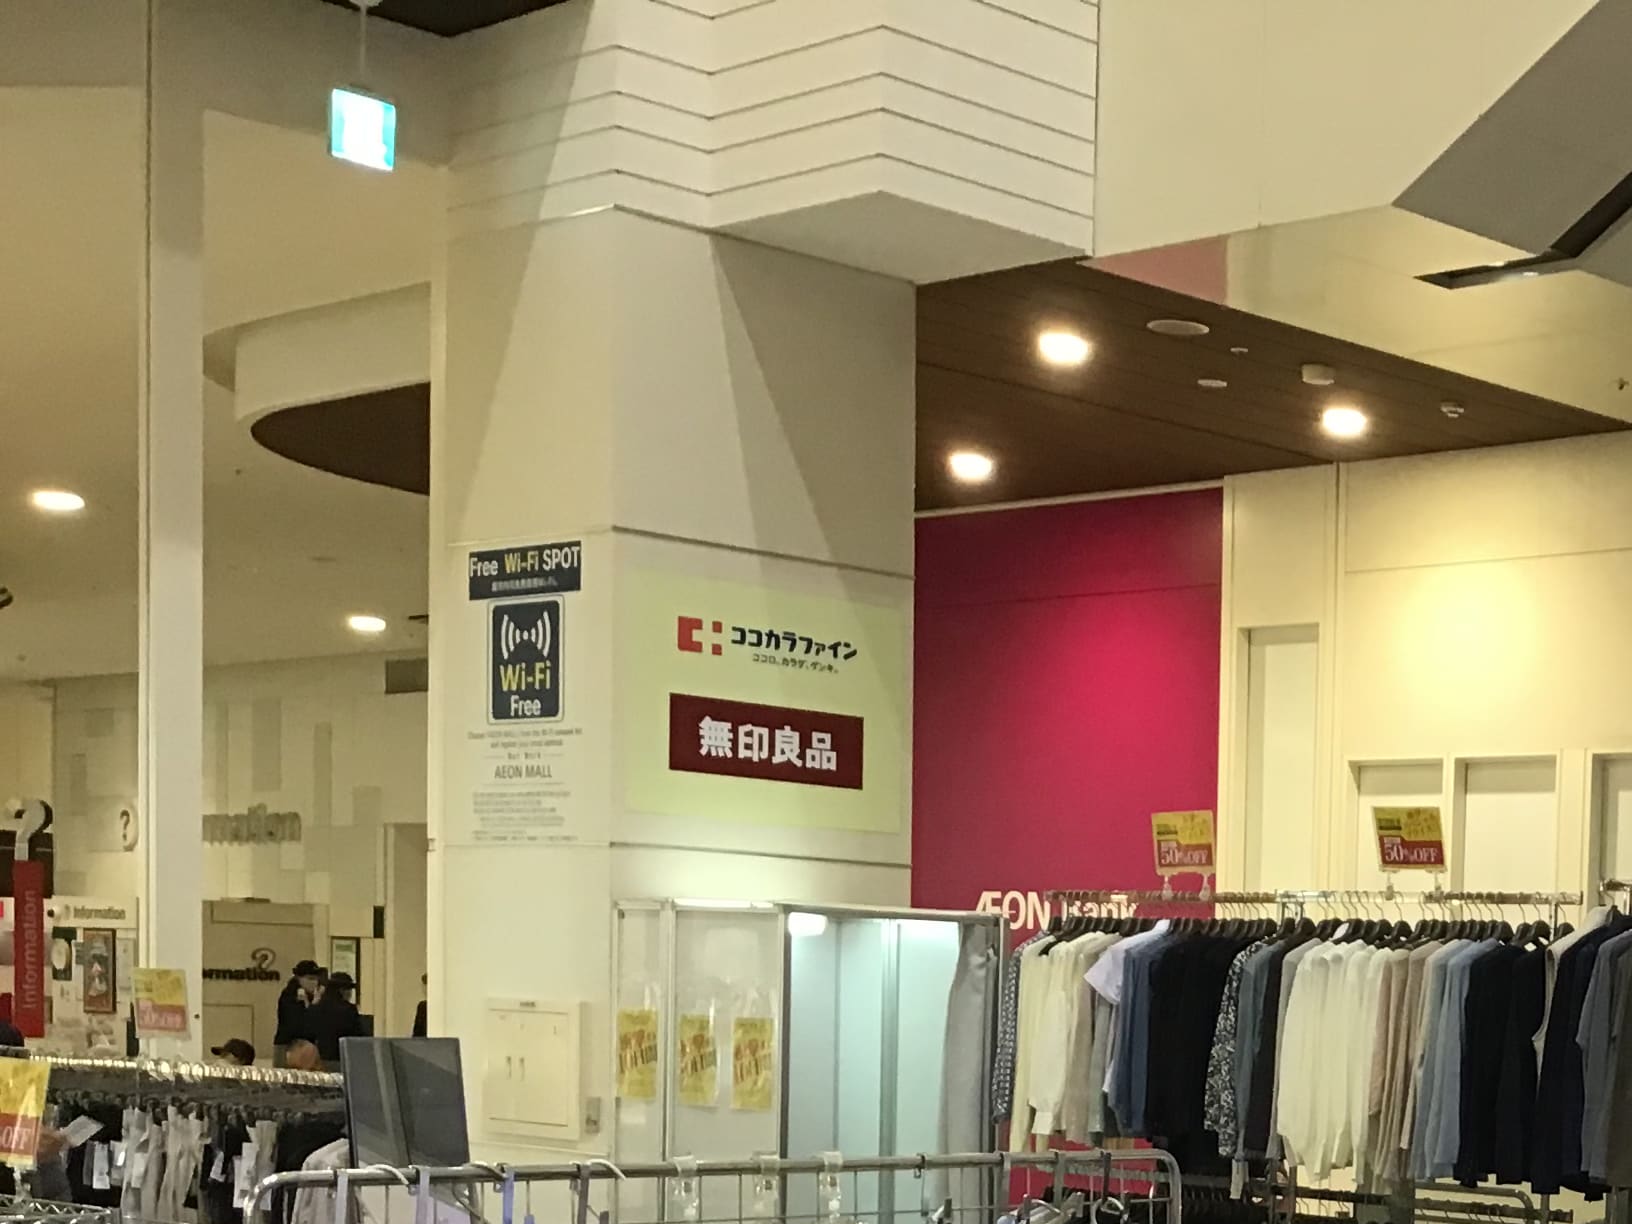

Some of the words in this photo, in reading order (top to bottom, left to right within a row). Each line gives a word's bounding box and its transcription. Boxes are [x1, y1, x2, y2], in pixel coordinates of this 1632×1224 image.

[470, 557, 499, 577] Free
[504, 551, 539, 574] Wi-Fi
[542, 546, 580, 571] SPOT
[731, 626, 858, 660] ココカラファイン
[500, 660, 551, 692] Wi-Fi
[510, 694, 542, 717] Free
[699, 715, 837, 771] 無印良品
[494, 765, 523, 779] AEON
[525, 764, 553, 779] MALL
[1384, 844, 1440, 863] 50%OFF
[22, 889, 38, 1008] Information
